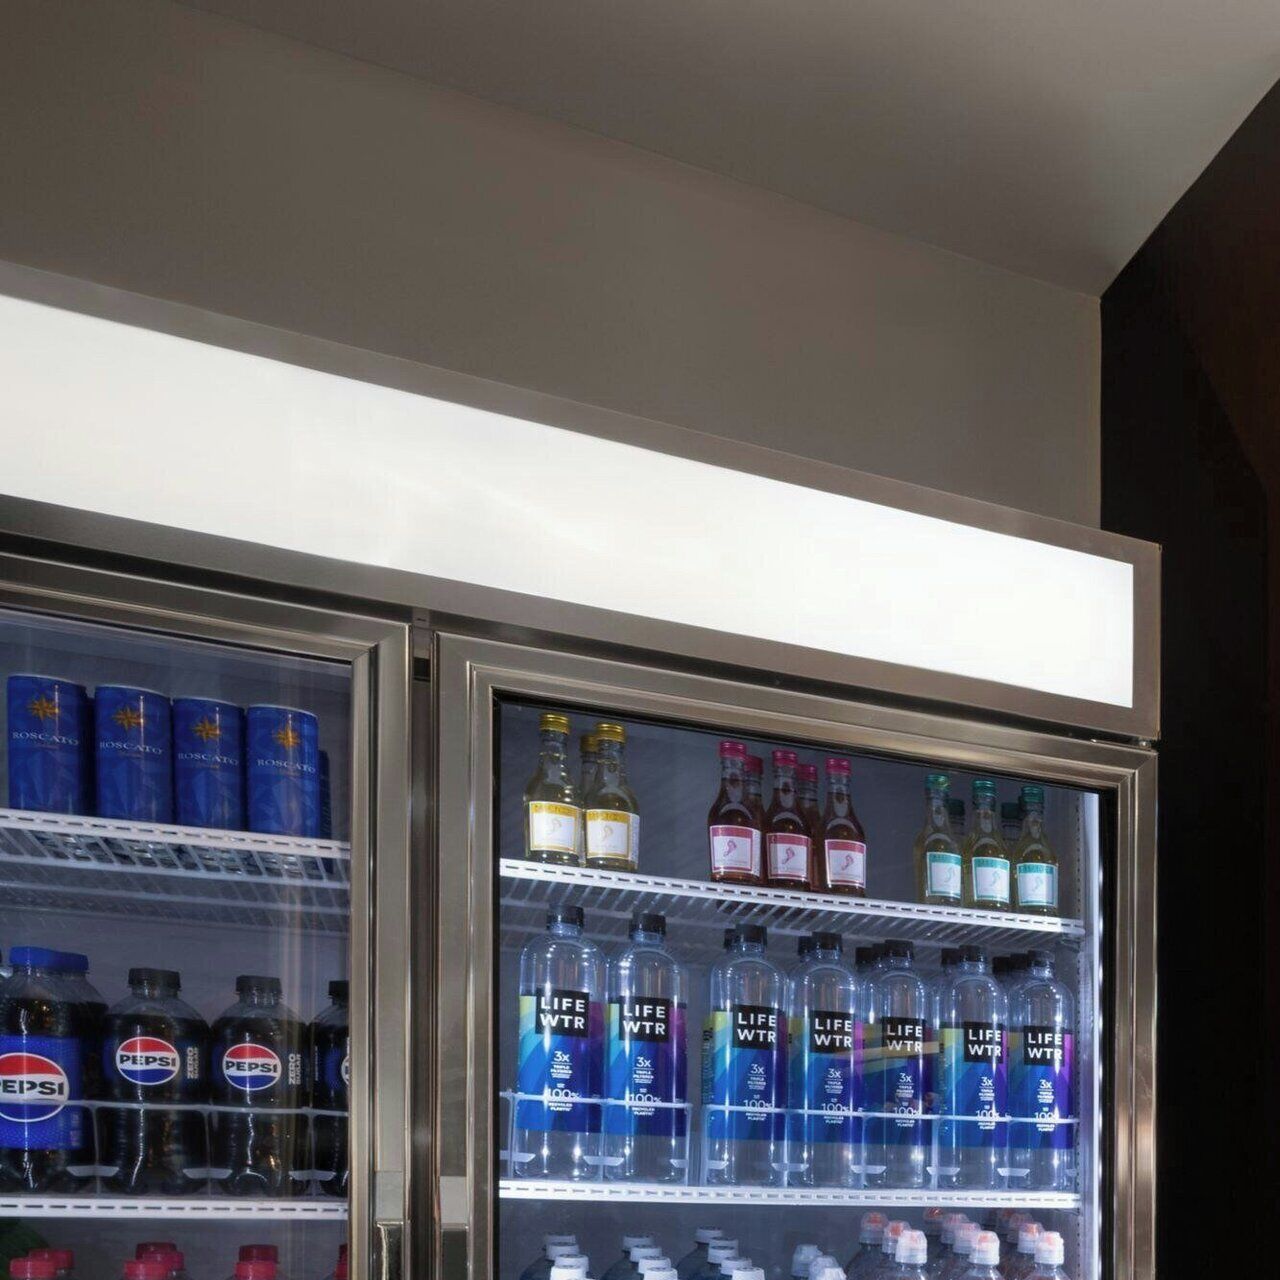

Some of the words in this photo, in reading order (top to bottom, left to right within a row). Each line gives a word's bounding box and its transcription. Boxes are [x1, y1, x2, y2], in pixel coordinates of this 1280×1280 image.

[541, 998, 585, 1012] LIFE
[623, 1004, 667, 1019] LIFE
[540, 1013, 585, 1030] WTR
[738, 1012, 777, 1027] LIFE
[815, 1017, 853, 1032] LIFE
[623, 1020, 667, 1035] WTR
[886, 1023, 923, 1038] LIFE
[737, 1029, 777, 1044] WTR
[814, 1033, 853, 1048] WTR
[968, 1028, 1002, 1042] LIFE
[1028, 1032, 1063, 1046] LIFE
[886, 1039, 923, 1053] WTR
[968, 1043, 1002, 1057] WTR
[119, 1054, 177, 1067] PEPSI
[1028, 1047, 1063, 1061] WTR
[225, 1060, 279, 1074] PEPSI
[636, 1056, 652, 1067] 3x
[0, 1078, 65, 1097] EPSI
